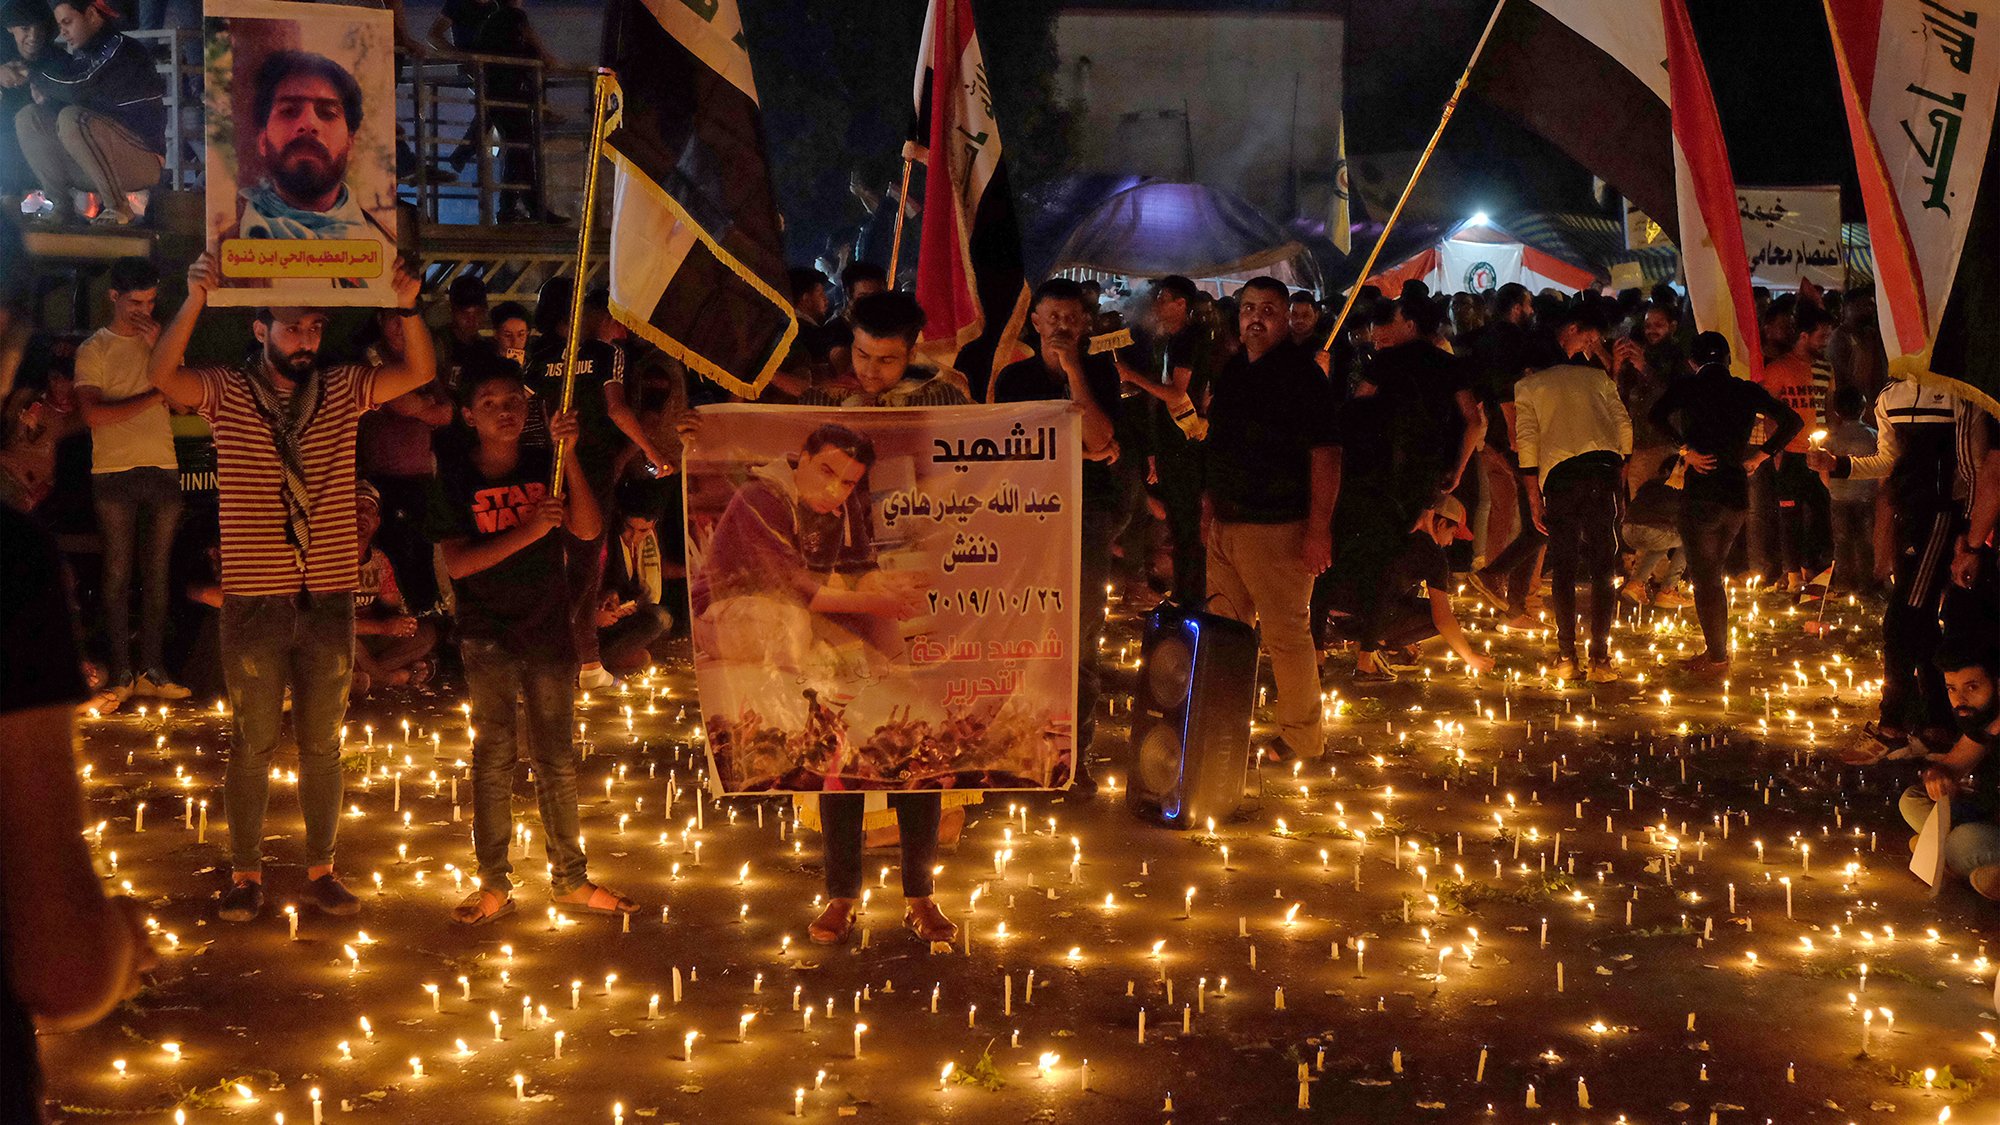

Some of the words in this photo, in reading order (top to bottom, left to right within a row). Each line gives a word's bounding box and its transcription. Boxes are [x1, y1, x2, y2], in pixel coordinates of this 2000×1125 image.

[1739, 196, 1788, 228] خيمة
[258, 251, 278, 267] ابن
[279, 251, 306, 269] الحي
[307, 251, 348, 267] العظيم
[1796, 239, 1843, 275] اعتصام
[932, 422, 1056, 473] الشهيد
[179, 472, 220, 491] HININ
[471, 482, 547, 512] STAR
[883, 489, 932, 526] هادي
[933, 490, 983, 523] حيدر
[986, 482, 1019, 514] الله
[1024, 489, 1061, 521] عبد
[474, 505, 531, 534] WA
[943, 532, 999, 573] دنفش
[911, 634, 982, 664] ساحة
[987, 628, 1064, 668] شهيد
[941, 669, 1026, 706] التحرير
